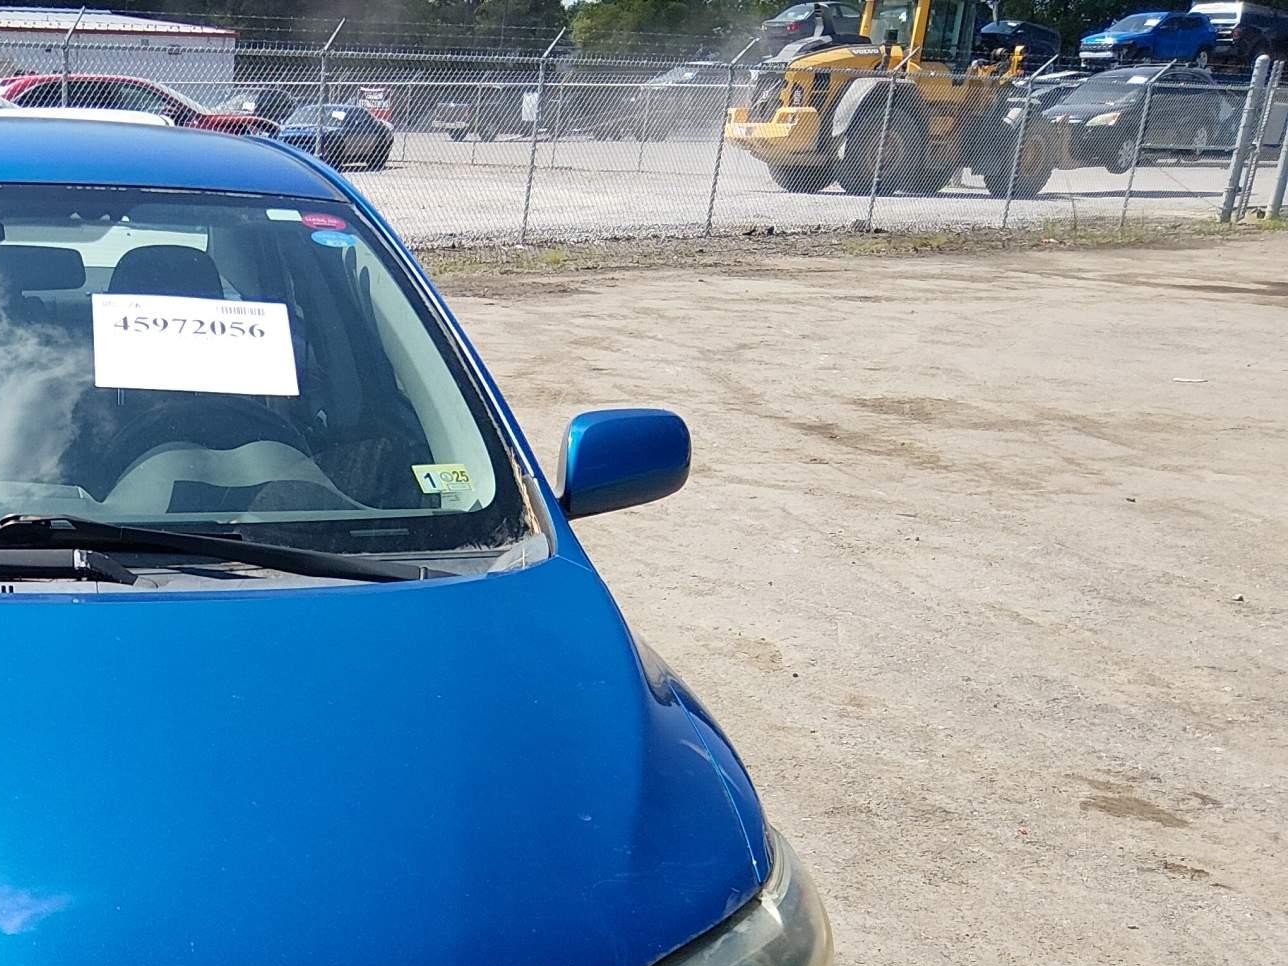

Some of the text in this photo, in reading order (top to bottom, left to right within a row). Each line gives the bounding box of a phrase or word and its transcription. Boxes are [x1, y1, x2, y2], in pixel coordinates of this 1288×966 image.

[114, 315, 266, 338] 45972056
[423, 470, 470, 489] 1 25
